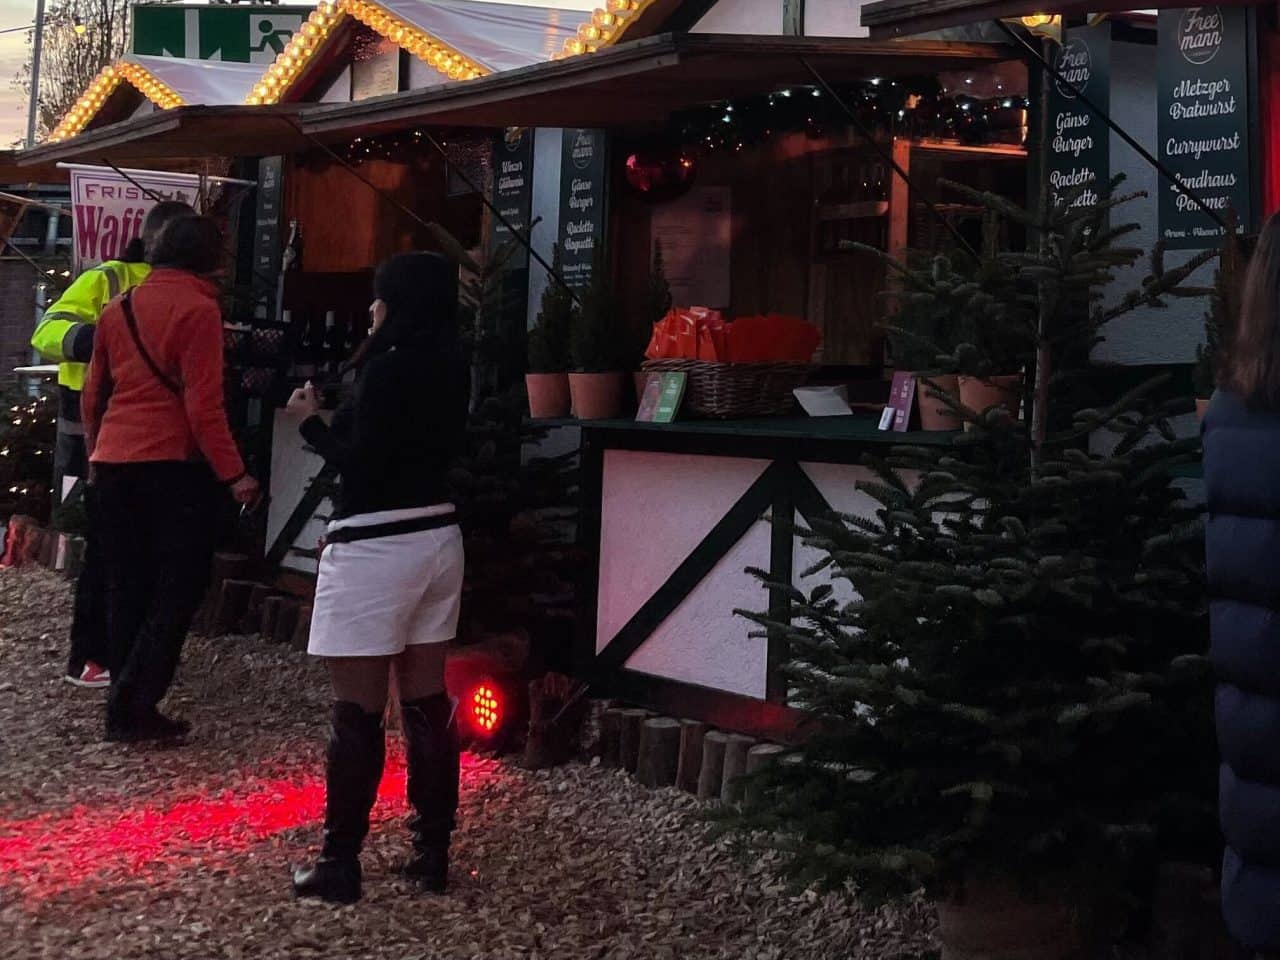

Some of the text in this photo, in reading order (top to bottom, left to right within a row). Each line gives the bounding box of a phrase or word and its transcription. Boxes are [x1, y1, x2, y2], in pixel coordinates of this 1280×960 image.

[1186, 8, 1219, 32] Free
[1181, 32, 1221, 50] mann
[1060, 45, 1087, 68] Free
[1174, 79, 1230, 100] Metzger
[1170, 96, 1236, 119] Bratwurst
[1056, 112, 1089, 135] Gänse
[1052, 136, 1093, 157] Burger
[1166, 131, 1240, 160] Currywurst
[1050, 168, 1096, 190] Raclette
